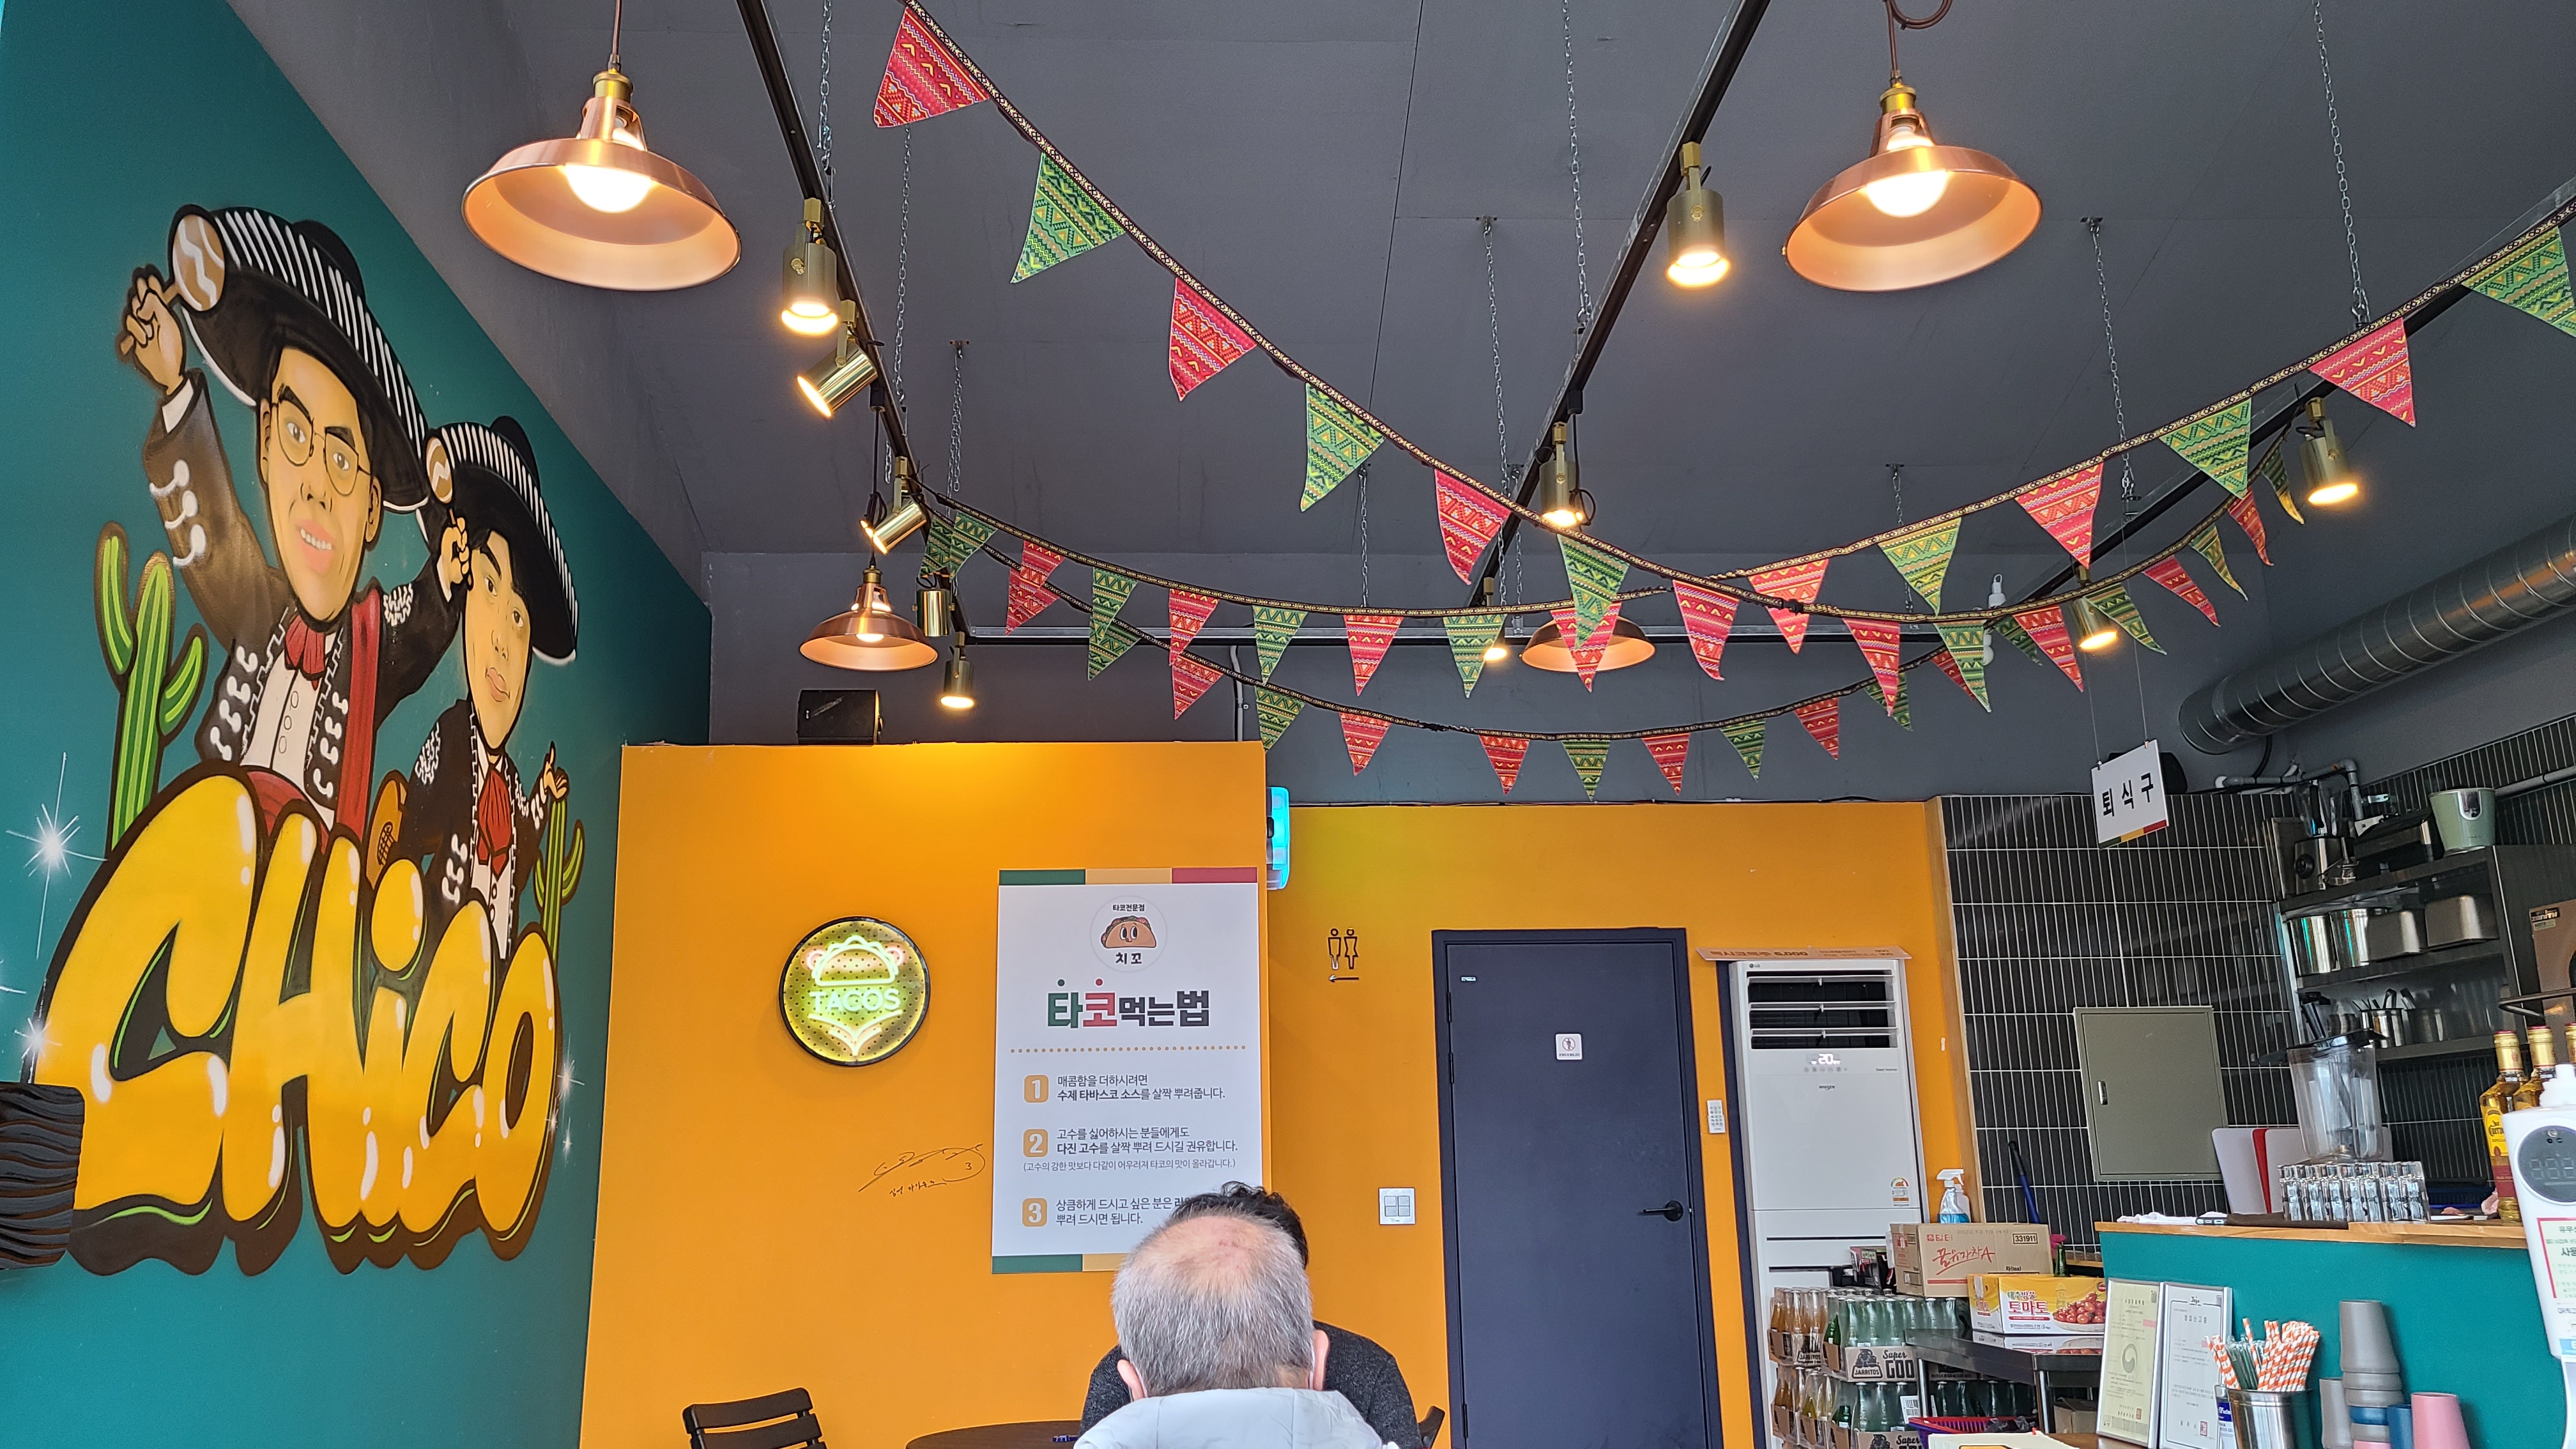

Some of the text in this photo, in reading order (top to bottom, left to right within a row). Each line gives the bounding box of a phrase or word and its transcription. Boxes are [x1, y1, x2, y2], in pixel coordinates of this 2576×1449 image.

[2102, 772, 2154, 817] 퇴식구
[1112, 903, 1145, 912] 타코전문점
[809, 988, 901, 1012] TACOS
[1057, 1074, 1148, 1087] 매콤함을 더하시려면
[1032, 1079, 1041, 1099] 1
[1057, 1087, 1226, 1101] 수제 타바스코 소스를 살짝 뿌려줍니다.
[1056, 1126, 1190, 1140] 고수를 싫어하시는 분들에게도
[1029, 1133, 1043, 1153] 2
[1057, 1140, 1238, 1155] 다진 고수를 살짝 뿌려 드시길 권유합니다.
[1023, 1158, 1236, 1172] (고수의 강한 맛보다 다같이 어우러져 타코의 맛이 올라갑니다.)
[1055, 1199, 1096, 1211] 상큼하게
[1098, 1198, 1128, 1211] 드시고
[1130, 1197, 1151, 1210] 싶은
[1151, 1197, 1172, 1209] 분은
[1028, 1202, 1042, 1223] 3
[1055, 1212, 1143, 1226] 뿌려 드시면 됩니다.
[2007, 1291, 2037, 1300] 대추방울
[2007, 1300, 2050, 1315] 토마토
[1882, 1349, 1908, 1361] Super
[1885, 1360, 1915, 1379] GOO
[1896, 1434, 1921, 1446] Super
